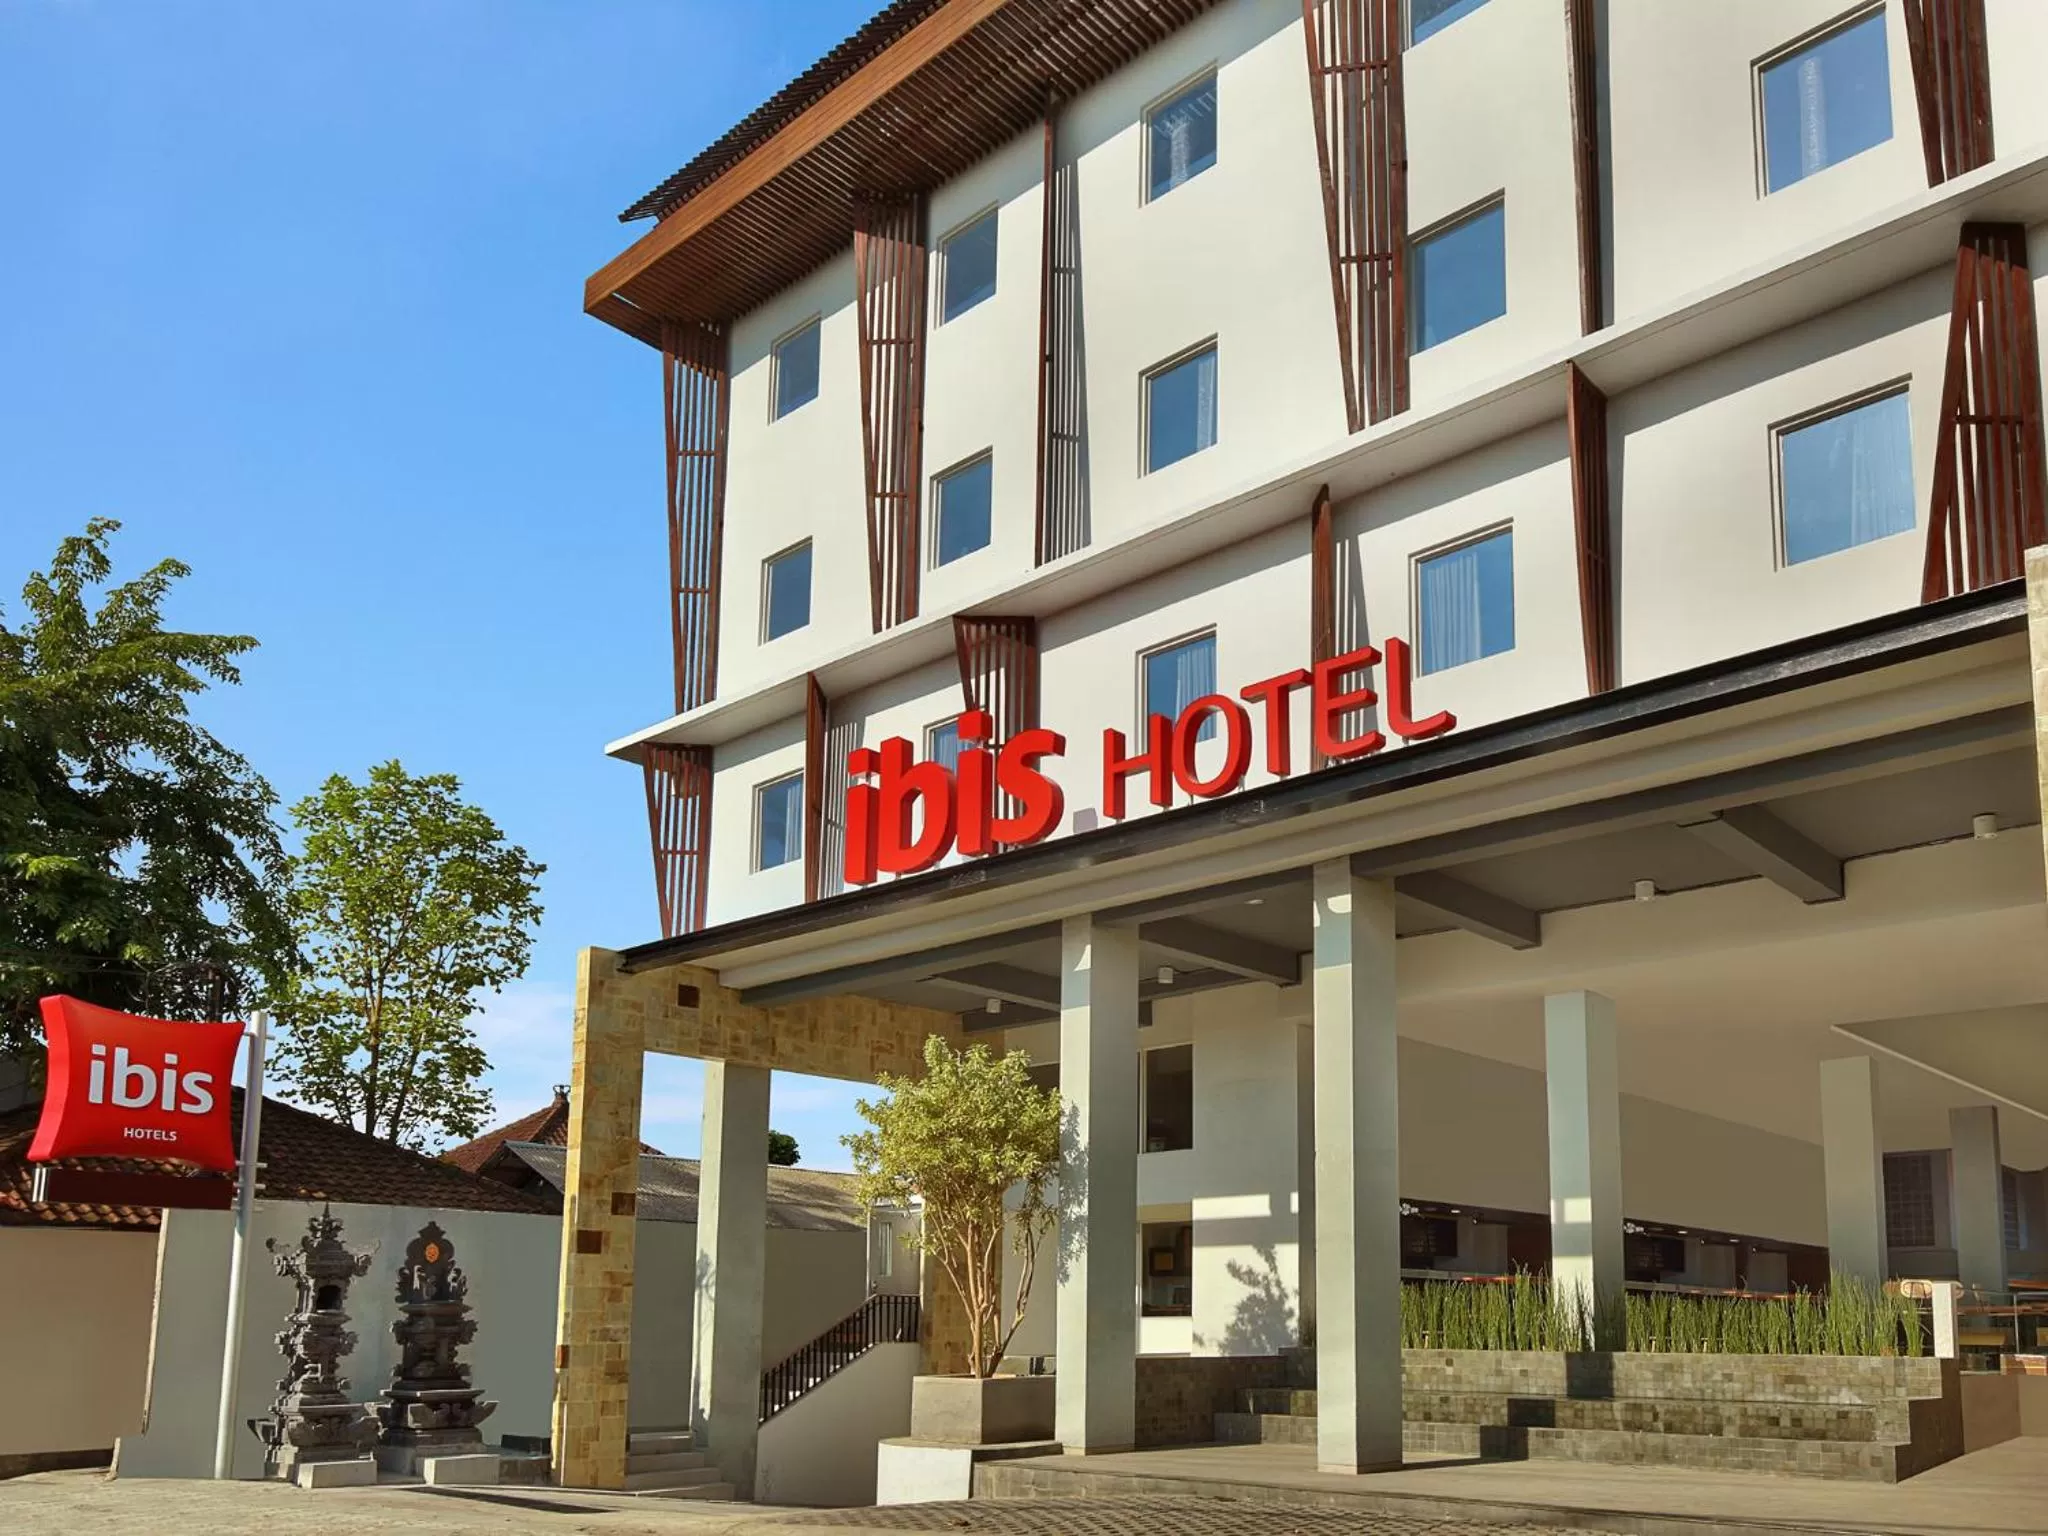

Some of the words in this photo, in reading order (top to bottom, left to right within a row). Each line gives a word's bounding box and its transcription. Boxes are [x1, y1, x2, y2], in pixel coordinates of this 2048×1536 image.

[844, 708, 1066, 885] ibis
[1103, 637, 1457, 820] HOTEL
[88, 1044, 214, 1114] ibis
[123, 1127, 177, 1141] HOTELS
